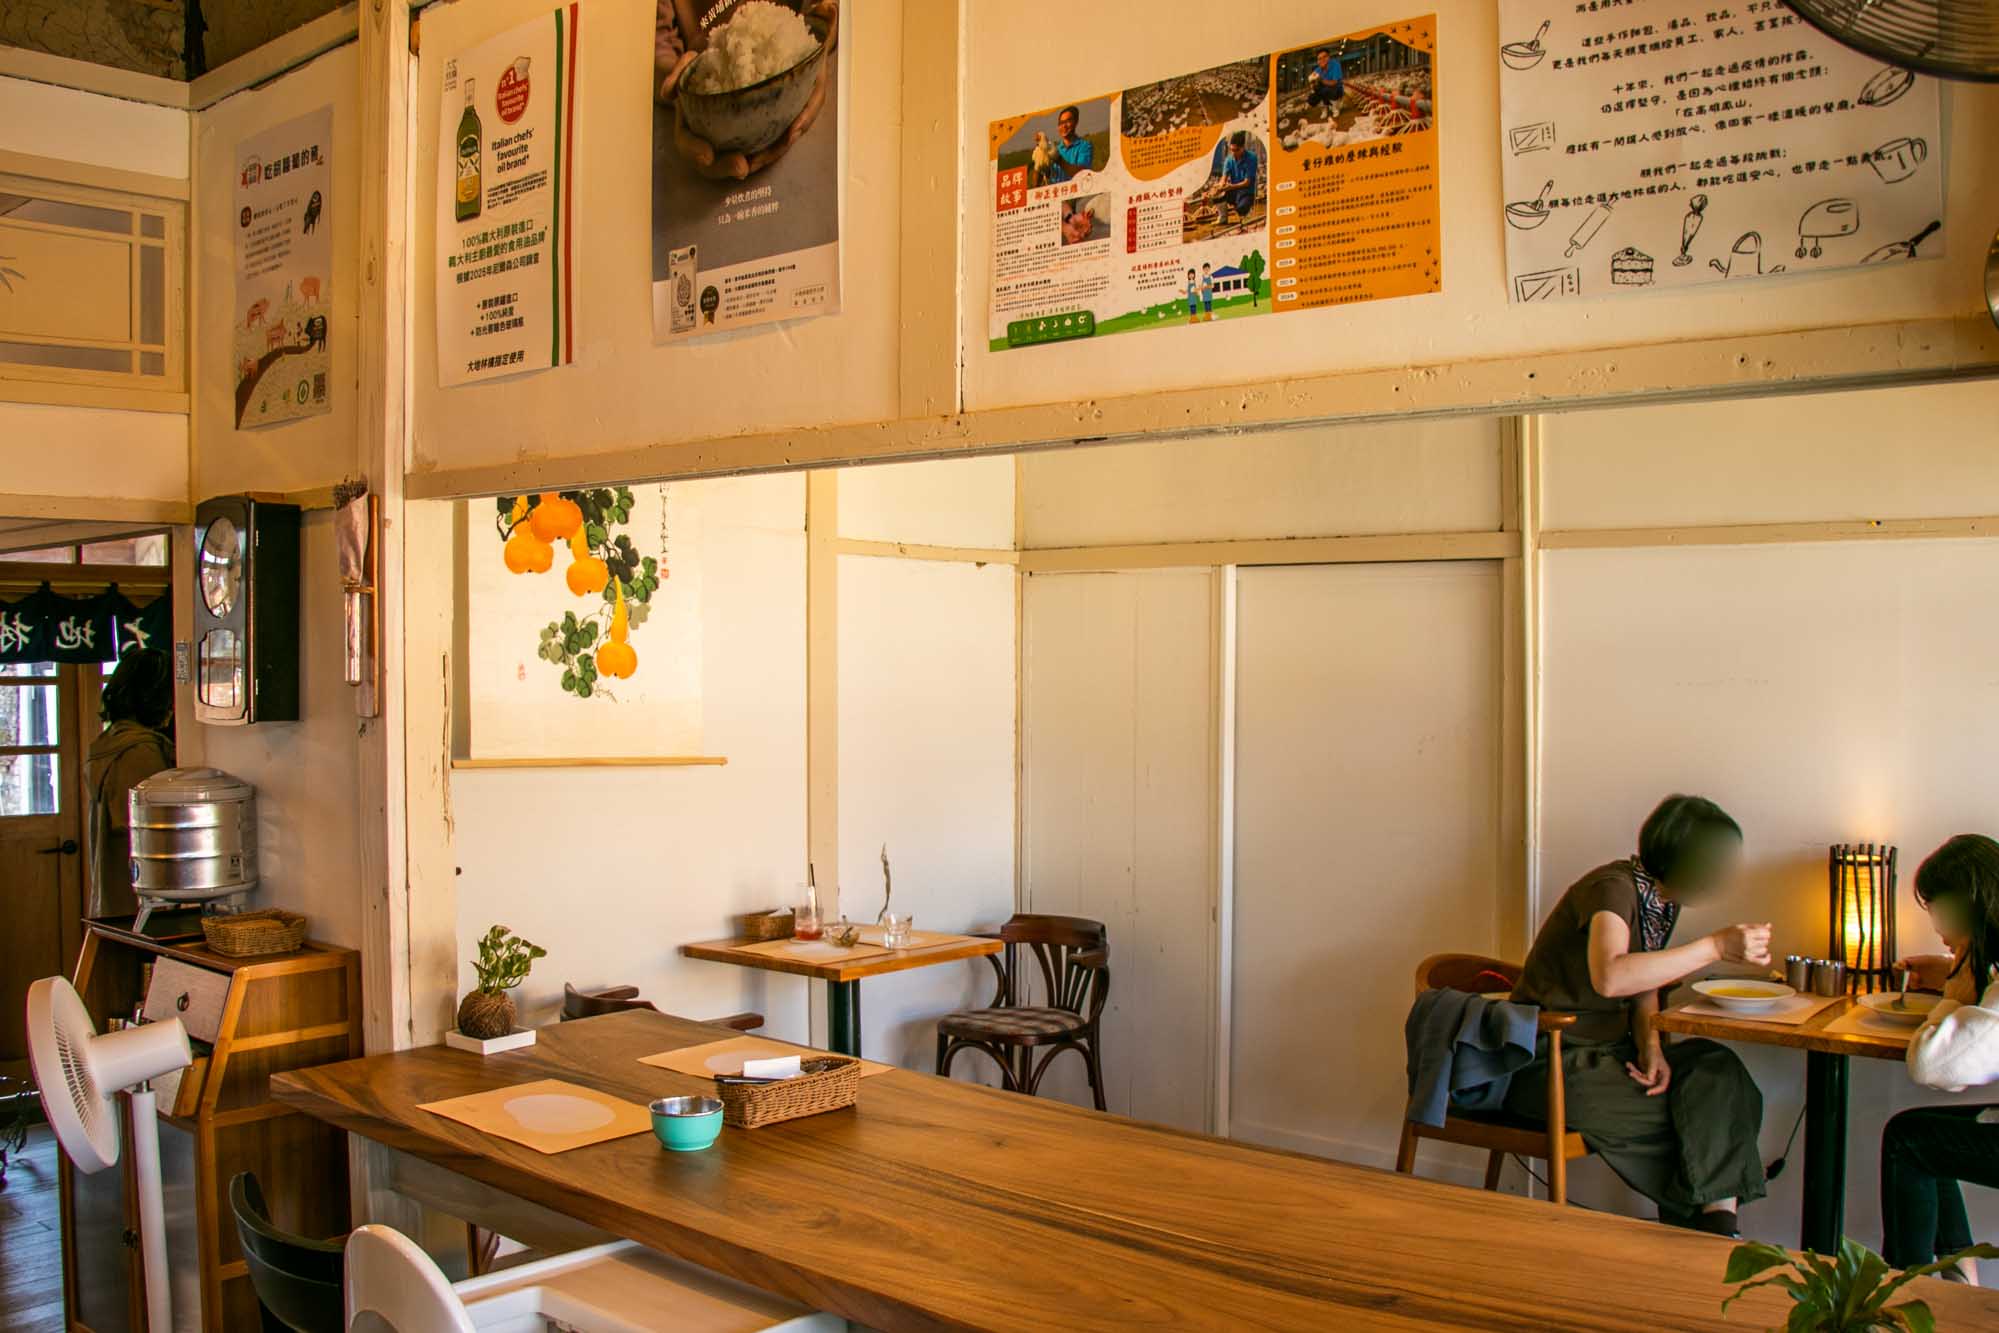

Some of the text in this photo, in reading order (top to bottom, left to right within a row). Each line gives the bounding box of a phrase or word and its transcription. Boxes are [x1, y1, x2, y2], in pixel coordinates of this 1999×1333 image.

[492, 137, 513, 151] Italian
[497, 143, 528, 161] favourite
[497, 161, 506, 174] oil
[1000, 189, 1022, 206] 故事
